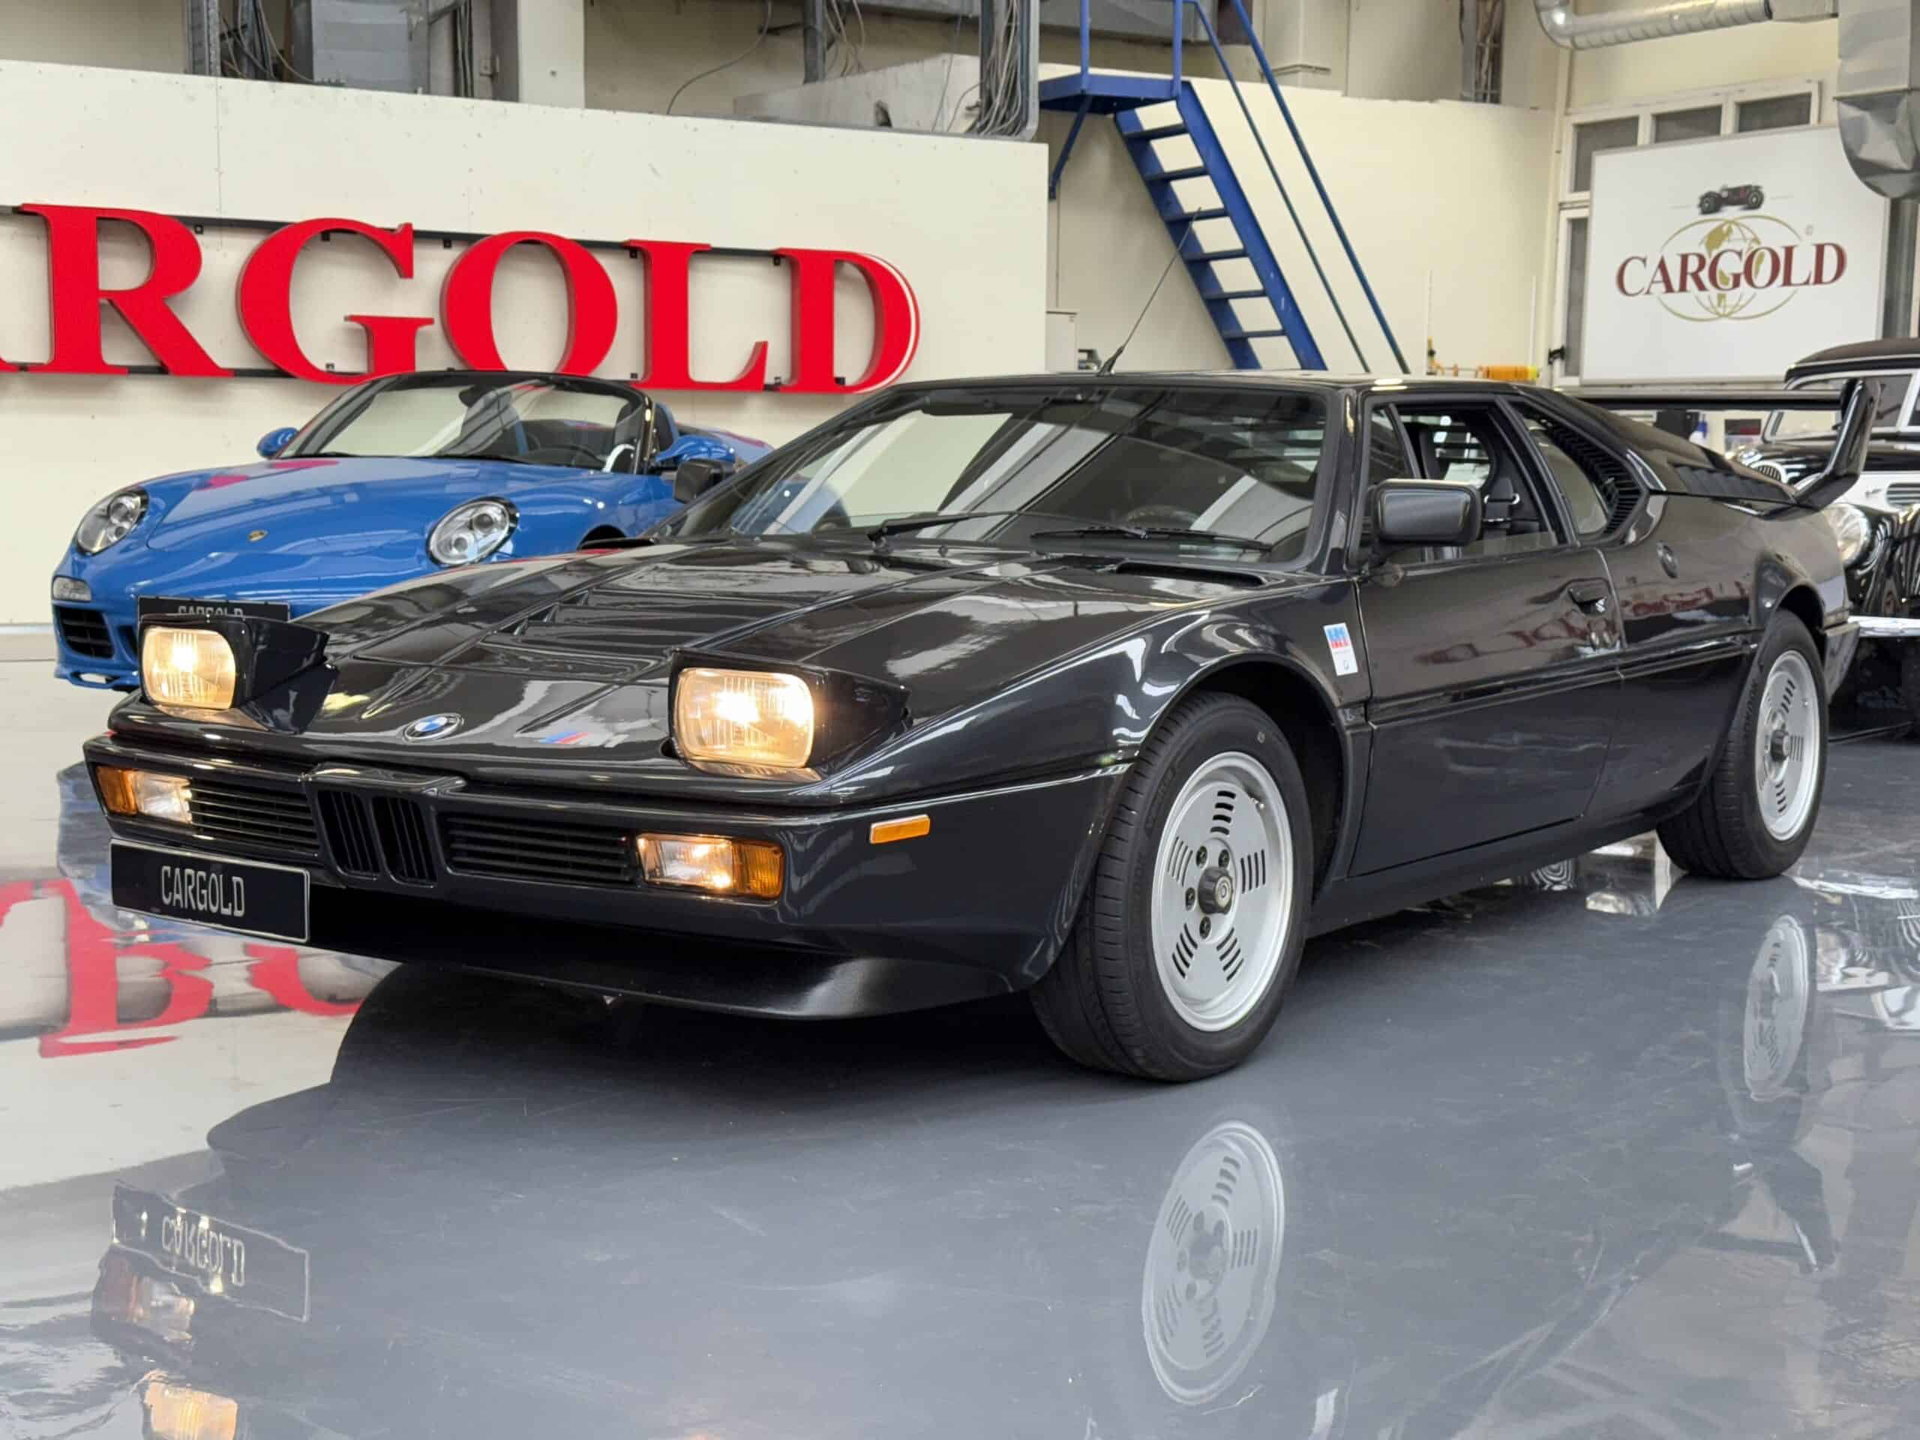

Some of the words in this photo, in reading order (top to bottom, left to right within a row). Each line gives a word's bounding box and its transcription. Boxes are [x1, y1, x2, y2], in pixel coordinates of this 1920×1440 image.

[1616, 242, 1848, 297] CARGOLD
[0, 202, 920, 395] RGOLD
[161, 865, 245, 917] CARGOLD
